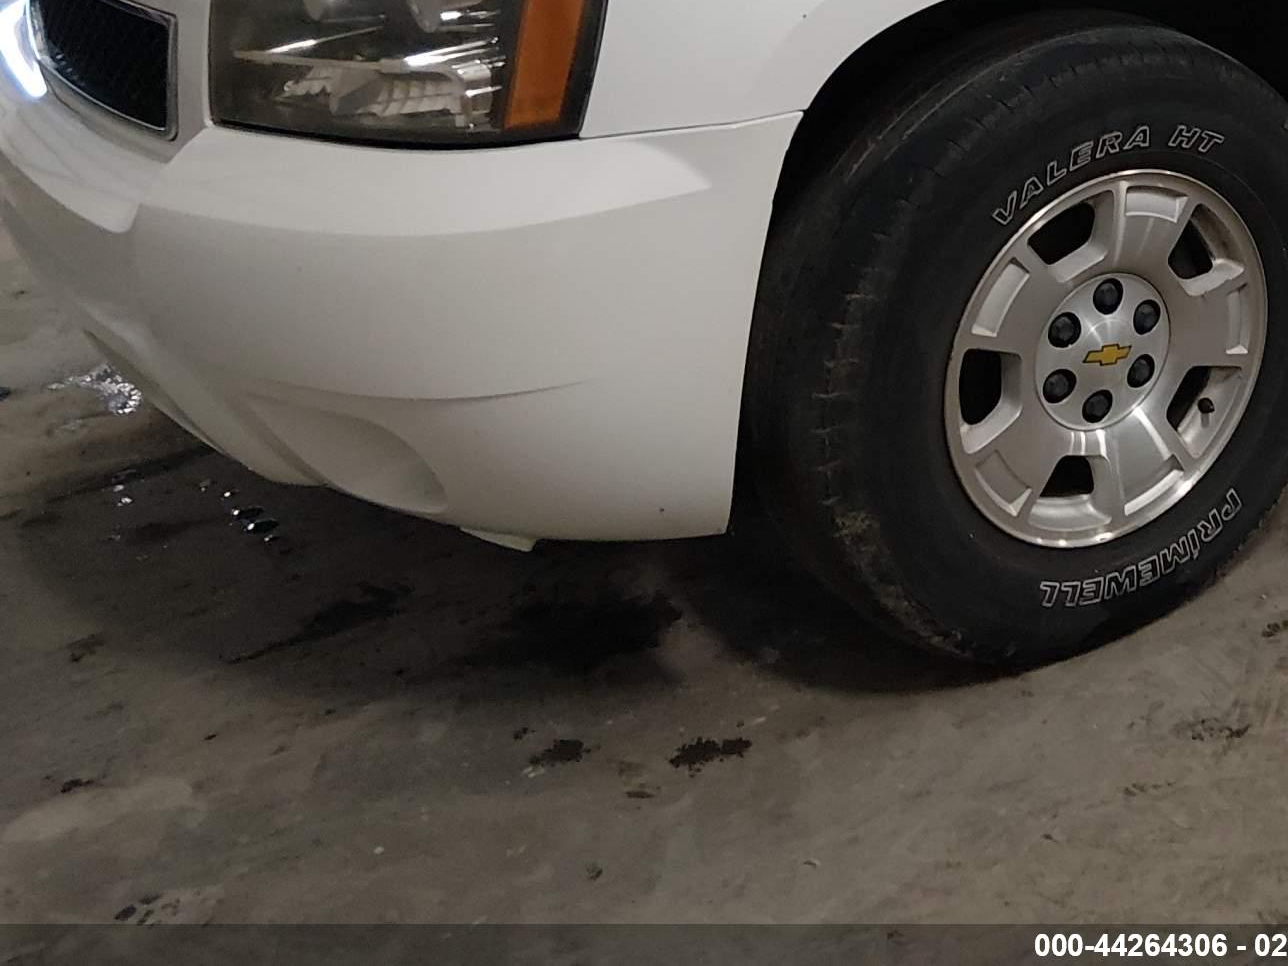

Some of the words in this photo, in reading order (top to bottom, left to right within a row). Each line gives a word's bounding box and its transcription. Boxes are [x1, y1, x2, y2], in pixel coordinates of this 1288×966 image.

[993, 124, 1151, 225] VALERA
[1169, 124, 1224, 155] HT
[1040, 489, 1242, 608] PRIMEWELL
